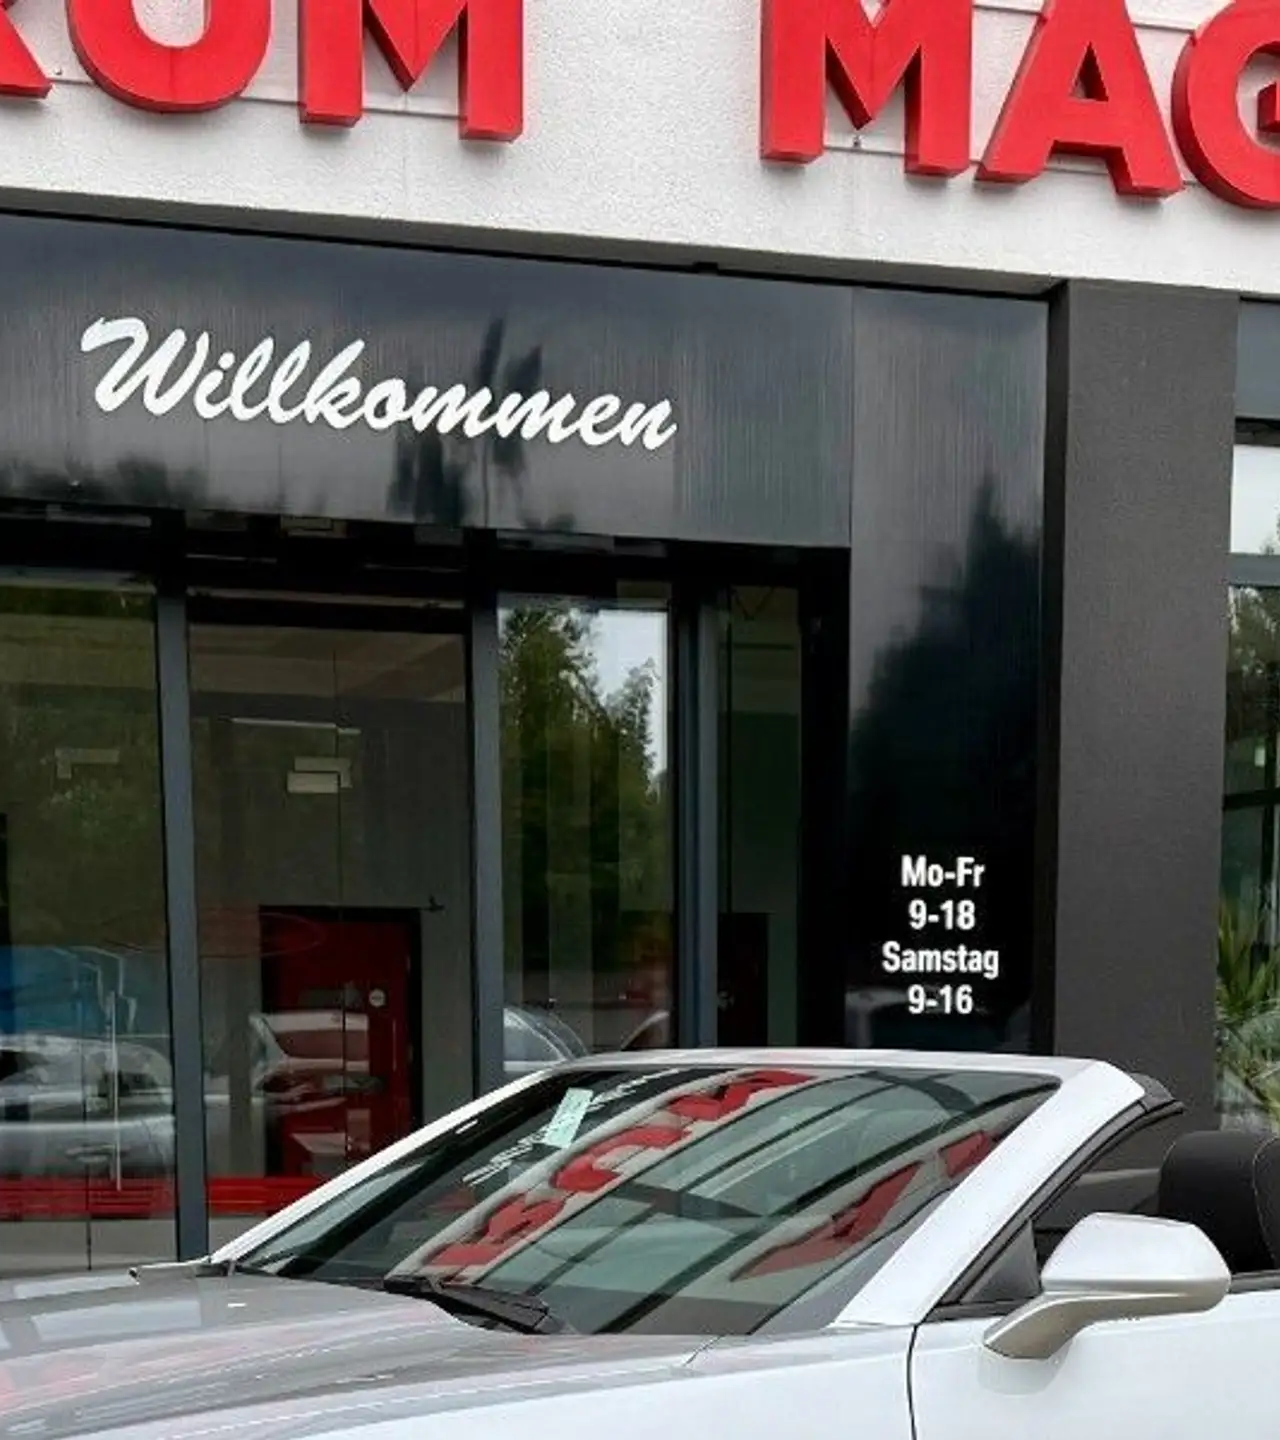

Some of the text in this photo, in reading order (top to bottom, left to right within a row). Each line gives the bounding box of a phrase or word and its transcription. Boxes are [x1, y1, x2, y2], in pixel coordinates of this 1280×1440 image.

[80, 315, 678, 459] Willkommen
[900, 854, 986, 888] Mo-Fr
[908, 898, 976, 931] 9-18
[881, 940, 999, 980] Samstag
[907, 983, 974, 1015] 9-16
